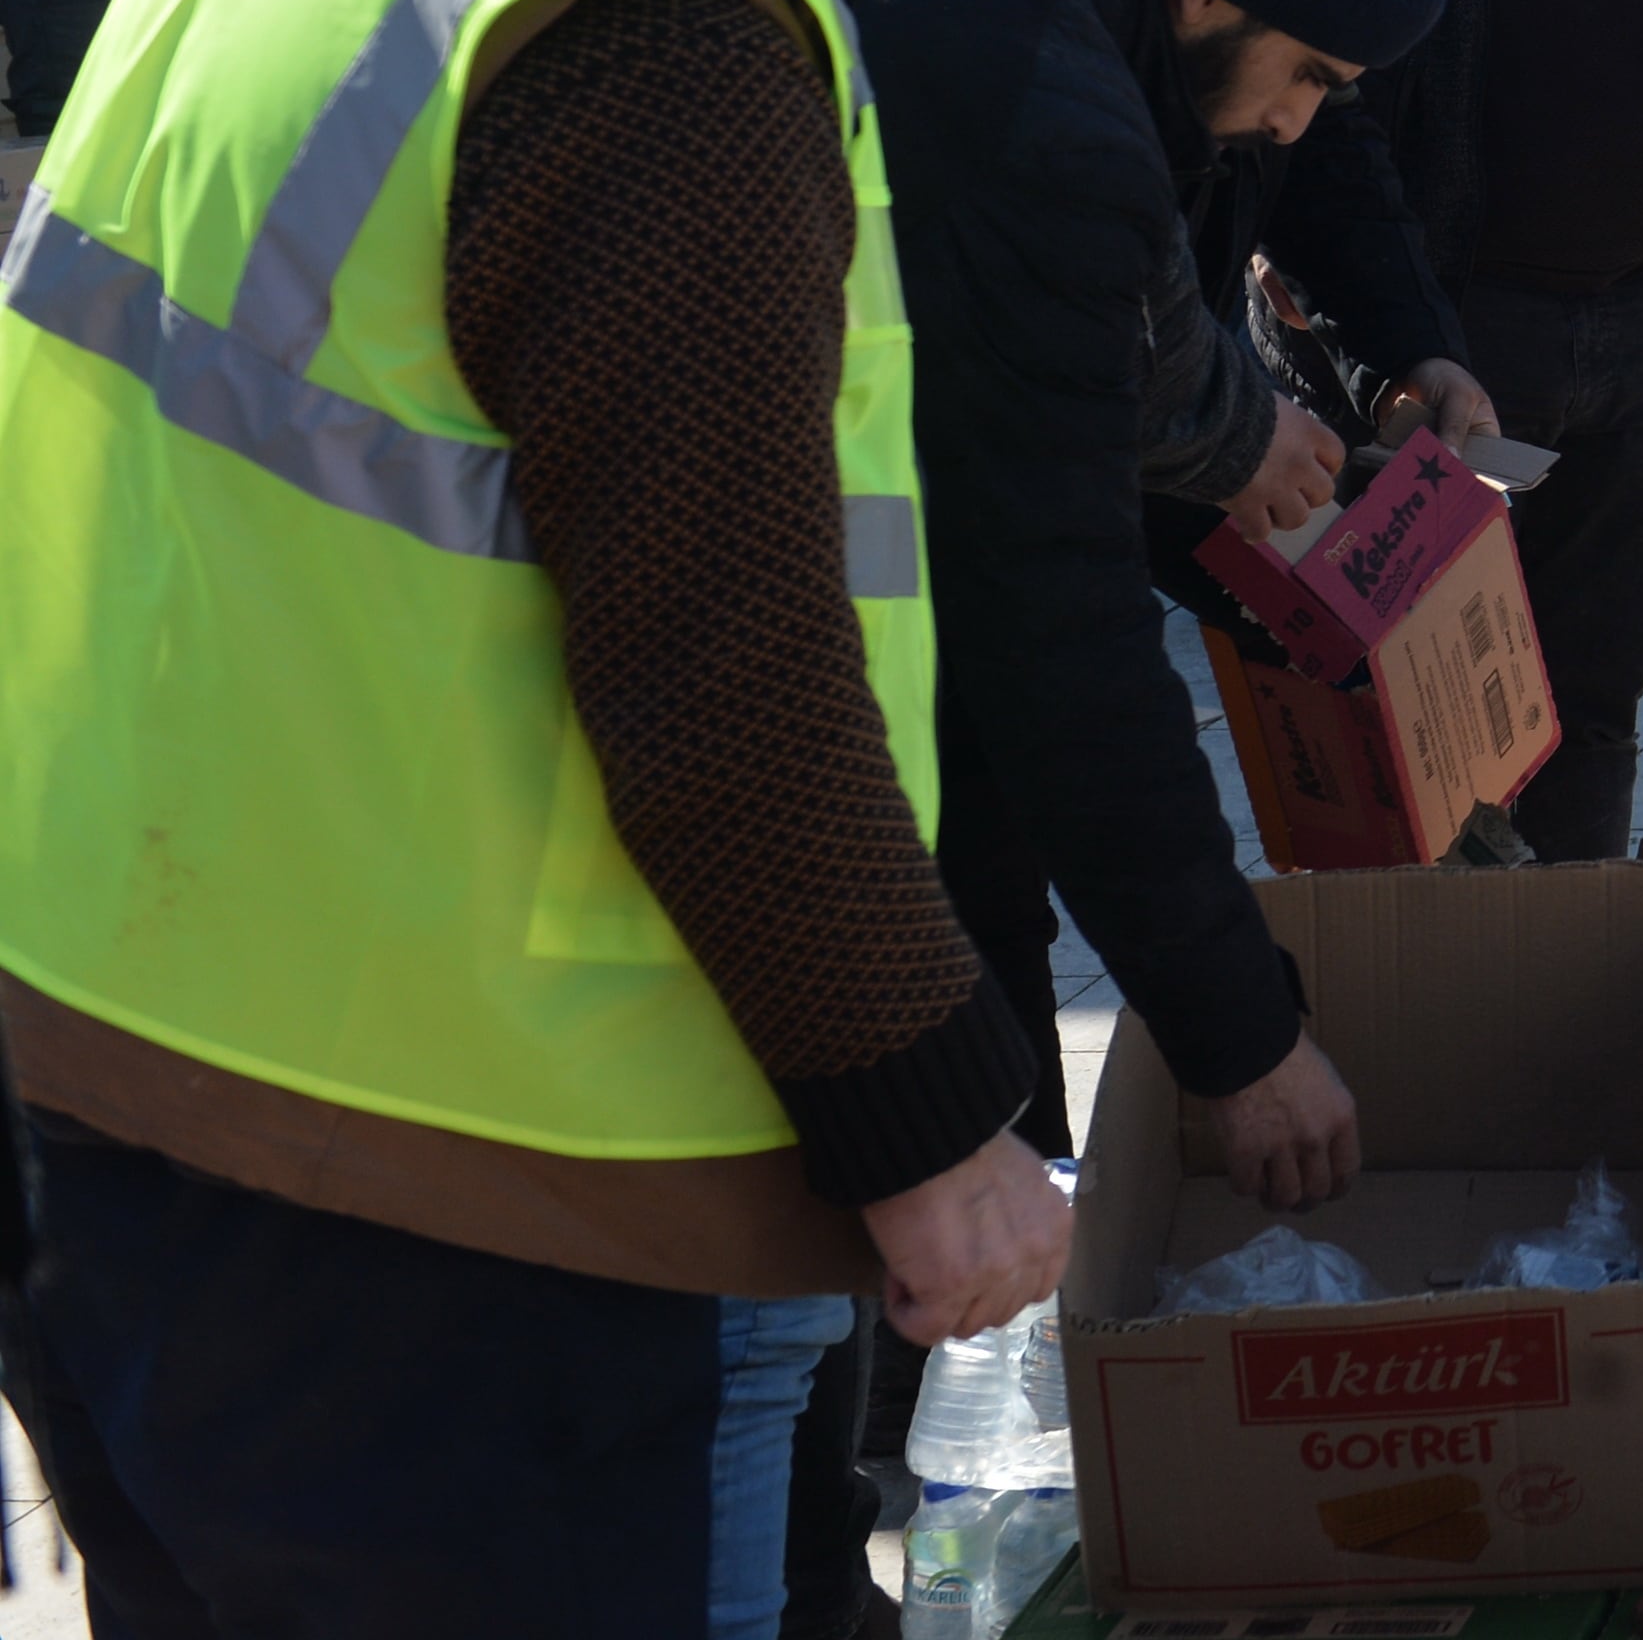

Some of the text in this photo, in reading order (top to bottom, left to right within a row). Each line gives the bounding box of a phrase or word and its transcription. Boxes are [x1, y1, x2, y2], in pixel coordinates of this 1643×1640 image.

[1341, 490, 1427, 600] Kekstra
[1283, 607, 1315, 636] 10
[1264, 1335, 1523, 1401] Aktürk
[1300, 1418, 1498, 1472] GOFRET
